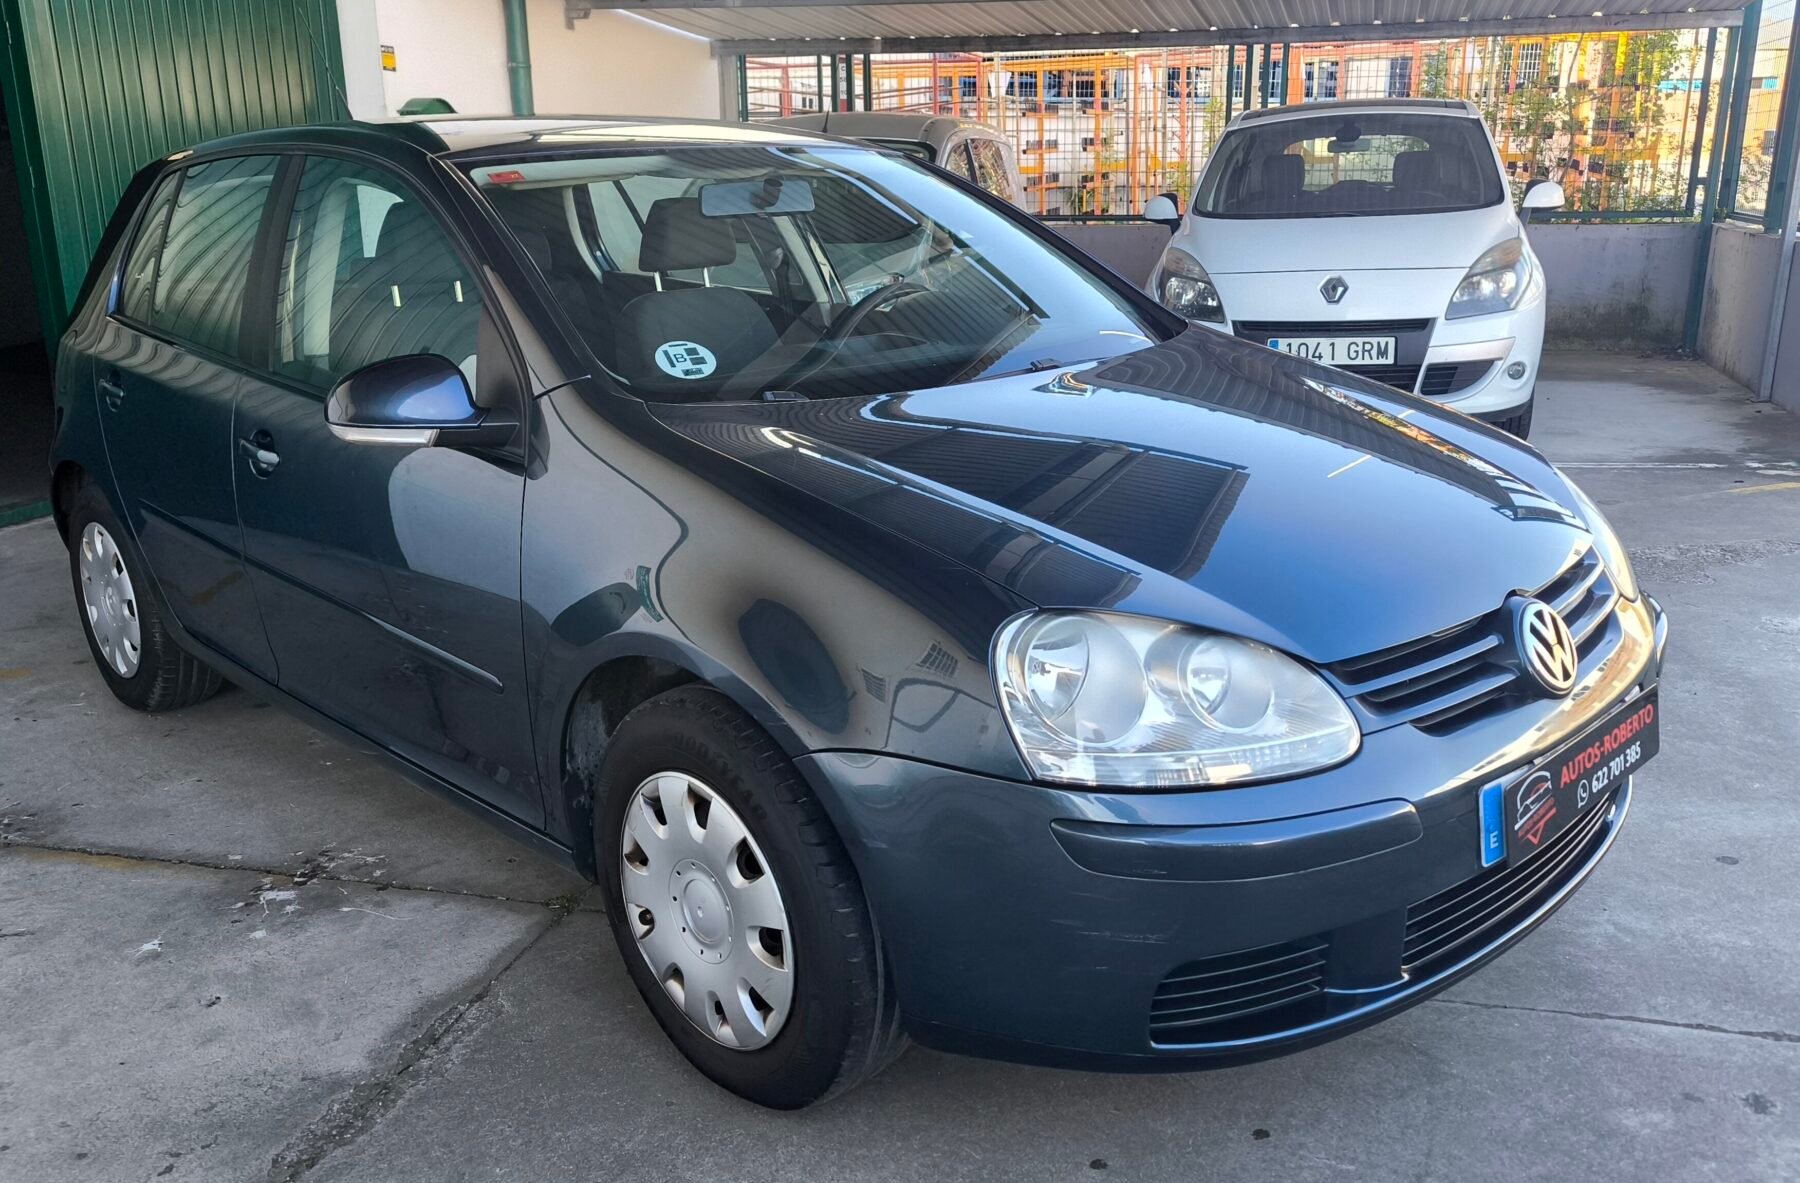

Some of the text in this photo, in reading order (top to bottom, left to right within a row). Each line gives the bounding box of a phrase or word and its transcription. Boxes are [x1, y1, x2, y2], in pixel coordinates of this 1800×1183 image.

[673, 353, 687, 363] B
[1286, 341, 1389, 361] 1041 GRM
[1560, 703, 1654, 789] AUTOS-ROBERTO
[1592, 741, 1641, 794] 622 701 385
[1490, 830, 1499, 849] E
